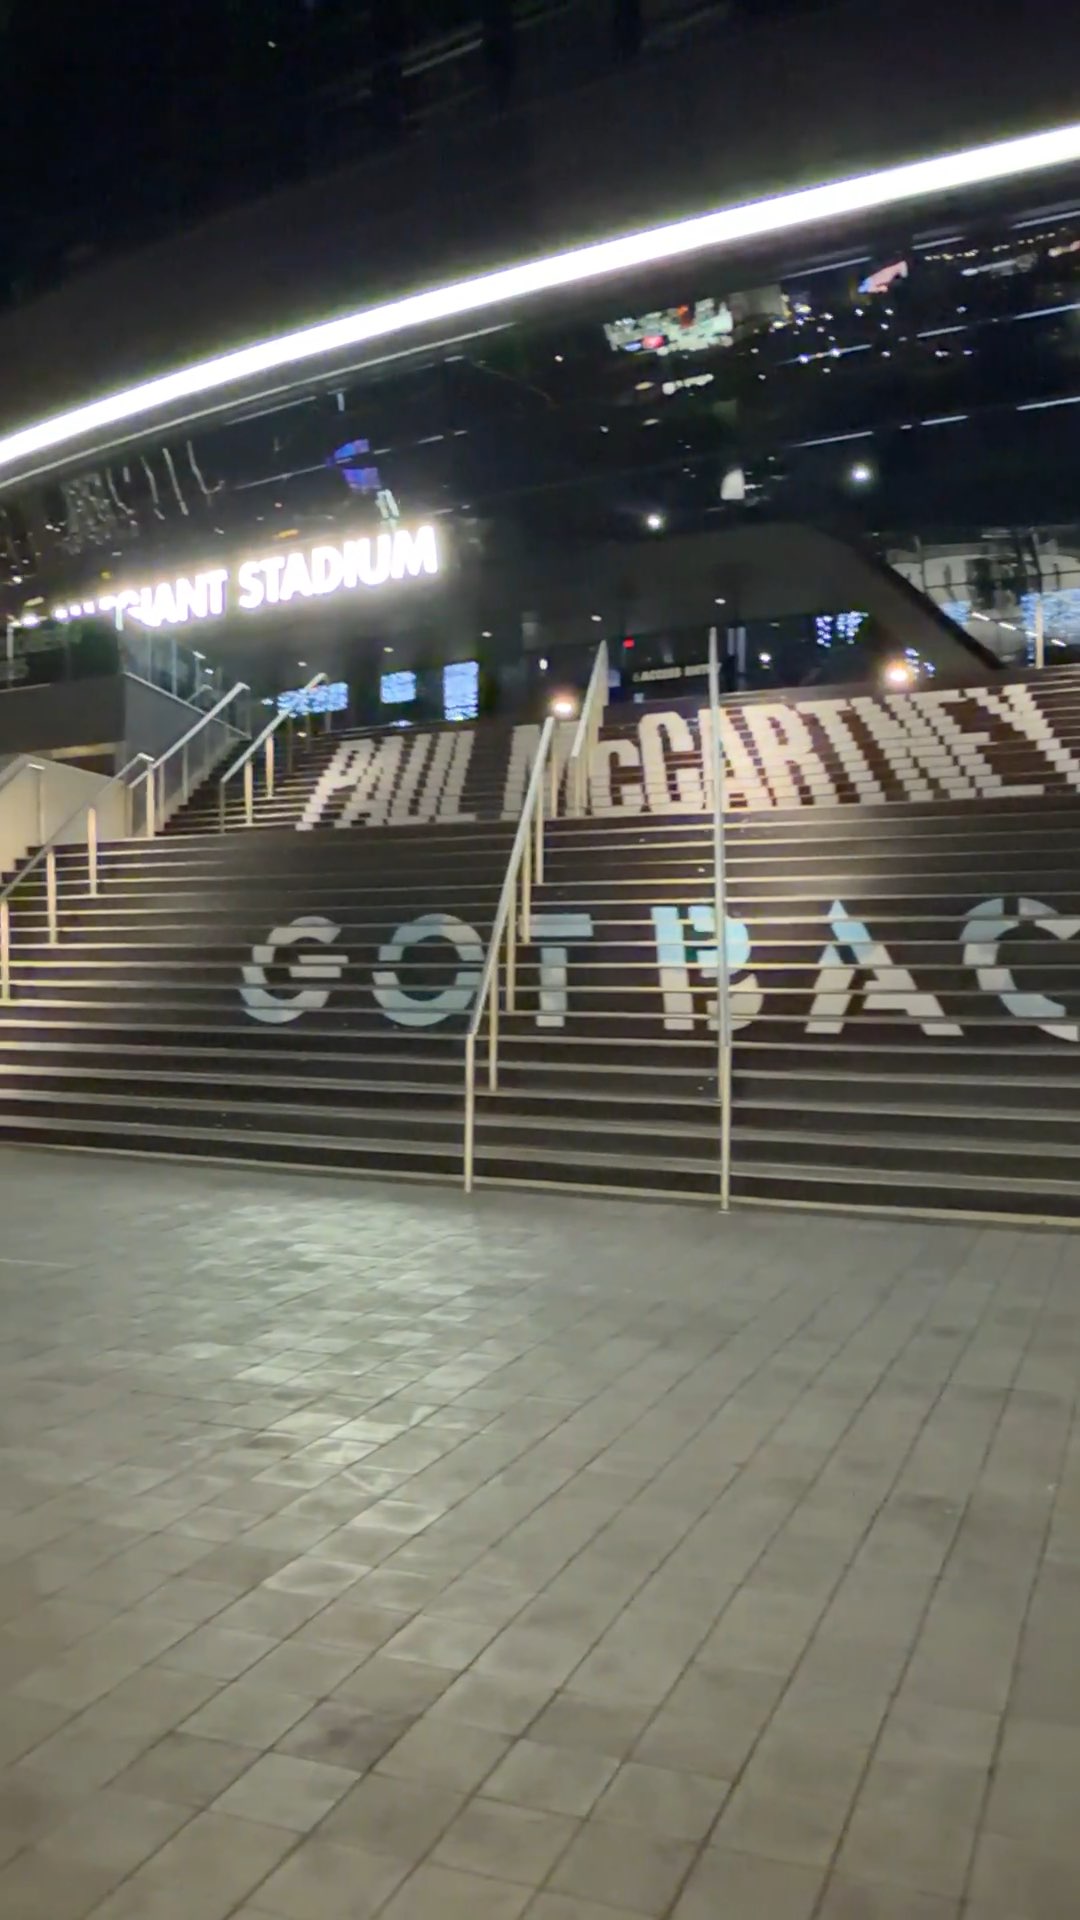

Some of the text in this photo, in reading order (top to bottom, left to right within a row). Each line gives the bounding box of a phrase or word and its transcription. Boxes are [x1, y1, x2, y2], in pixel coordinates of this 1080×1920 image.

[238, 525, 438, 609] STADIUM
[295, 730, 476, 831] PAUL
[239, 912, 593, 1028] GOT
